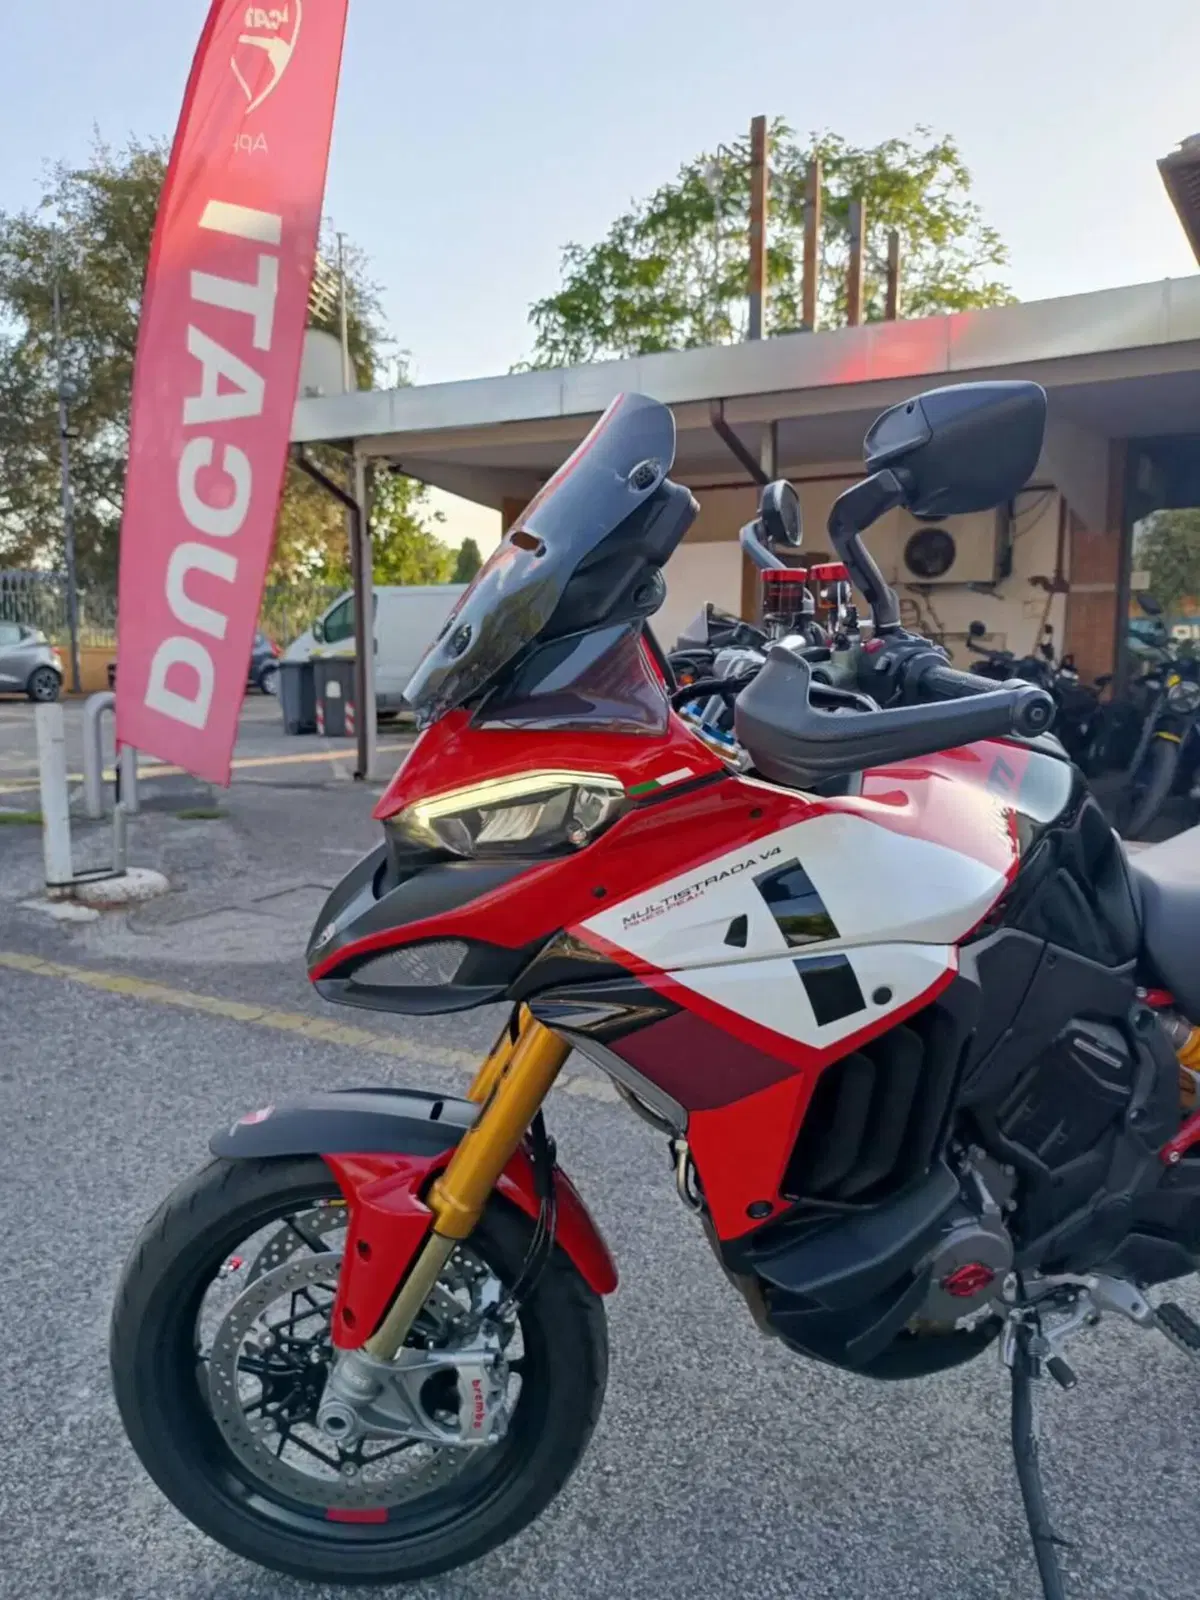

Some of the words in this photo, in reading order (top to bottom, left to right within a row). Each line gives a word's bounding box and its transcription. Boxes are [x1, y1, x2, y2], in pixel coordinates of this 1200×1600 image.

[622, 859, 757, 926] MULTISTRADA
[758, 846, 782, 861] V4
[471, 1378, 486, 1429] brembo
